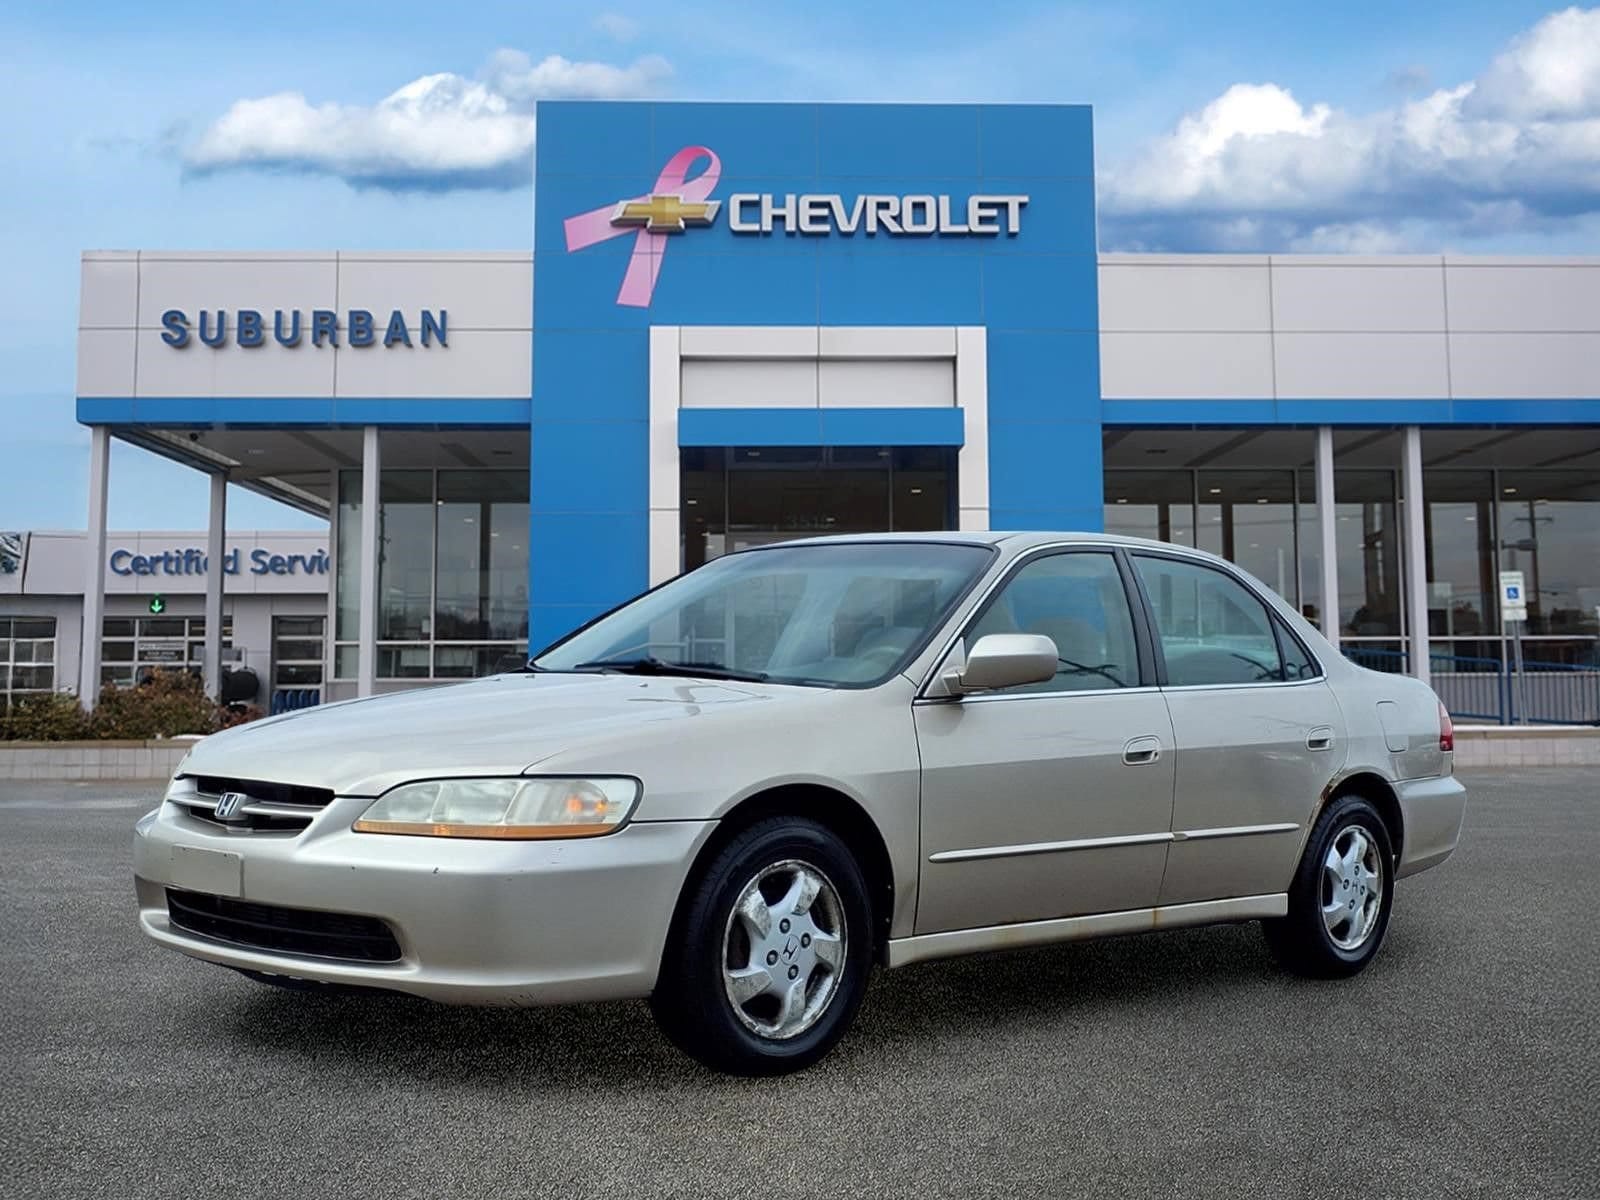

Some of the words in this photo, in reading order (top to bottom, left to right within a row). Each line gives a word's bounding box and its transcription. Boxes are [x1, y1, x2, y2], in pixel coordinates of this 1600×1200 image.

[729, 193, 1029, 233] CHEVROLET
[161, 310, 448, 348] SUBURBAN
[110, 548, 240, 576] Certifid
[250, 548, 329, 576] Servi
